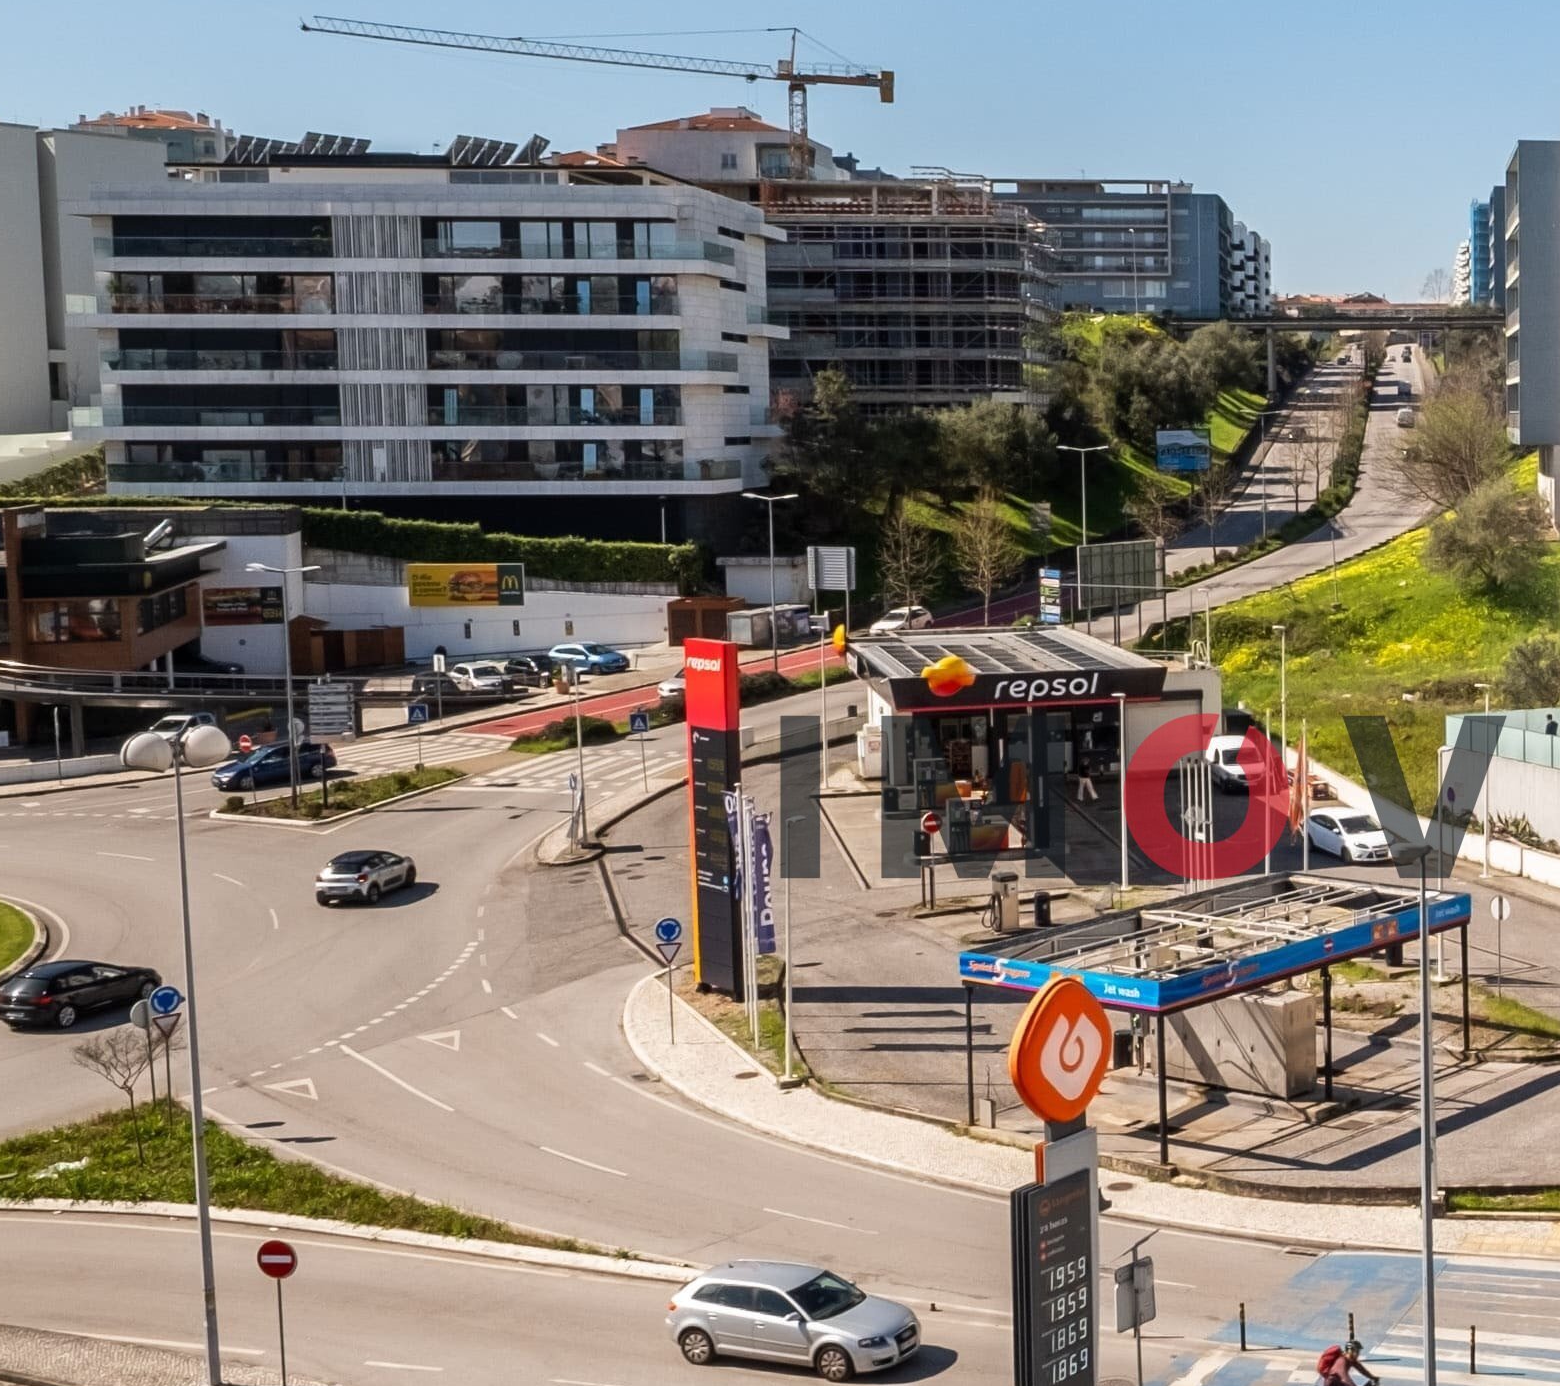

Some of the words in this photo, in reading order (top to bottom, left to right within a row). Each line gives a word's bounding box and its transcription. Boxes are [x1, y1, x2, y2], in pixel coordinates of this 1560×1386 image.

[687, 657, 721, 671] repsol
[994, 672, 1099, 702] repsol
[1103, 983, 1116, 995] Jet
[1118, 986, 1141, 999] wash
